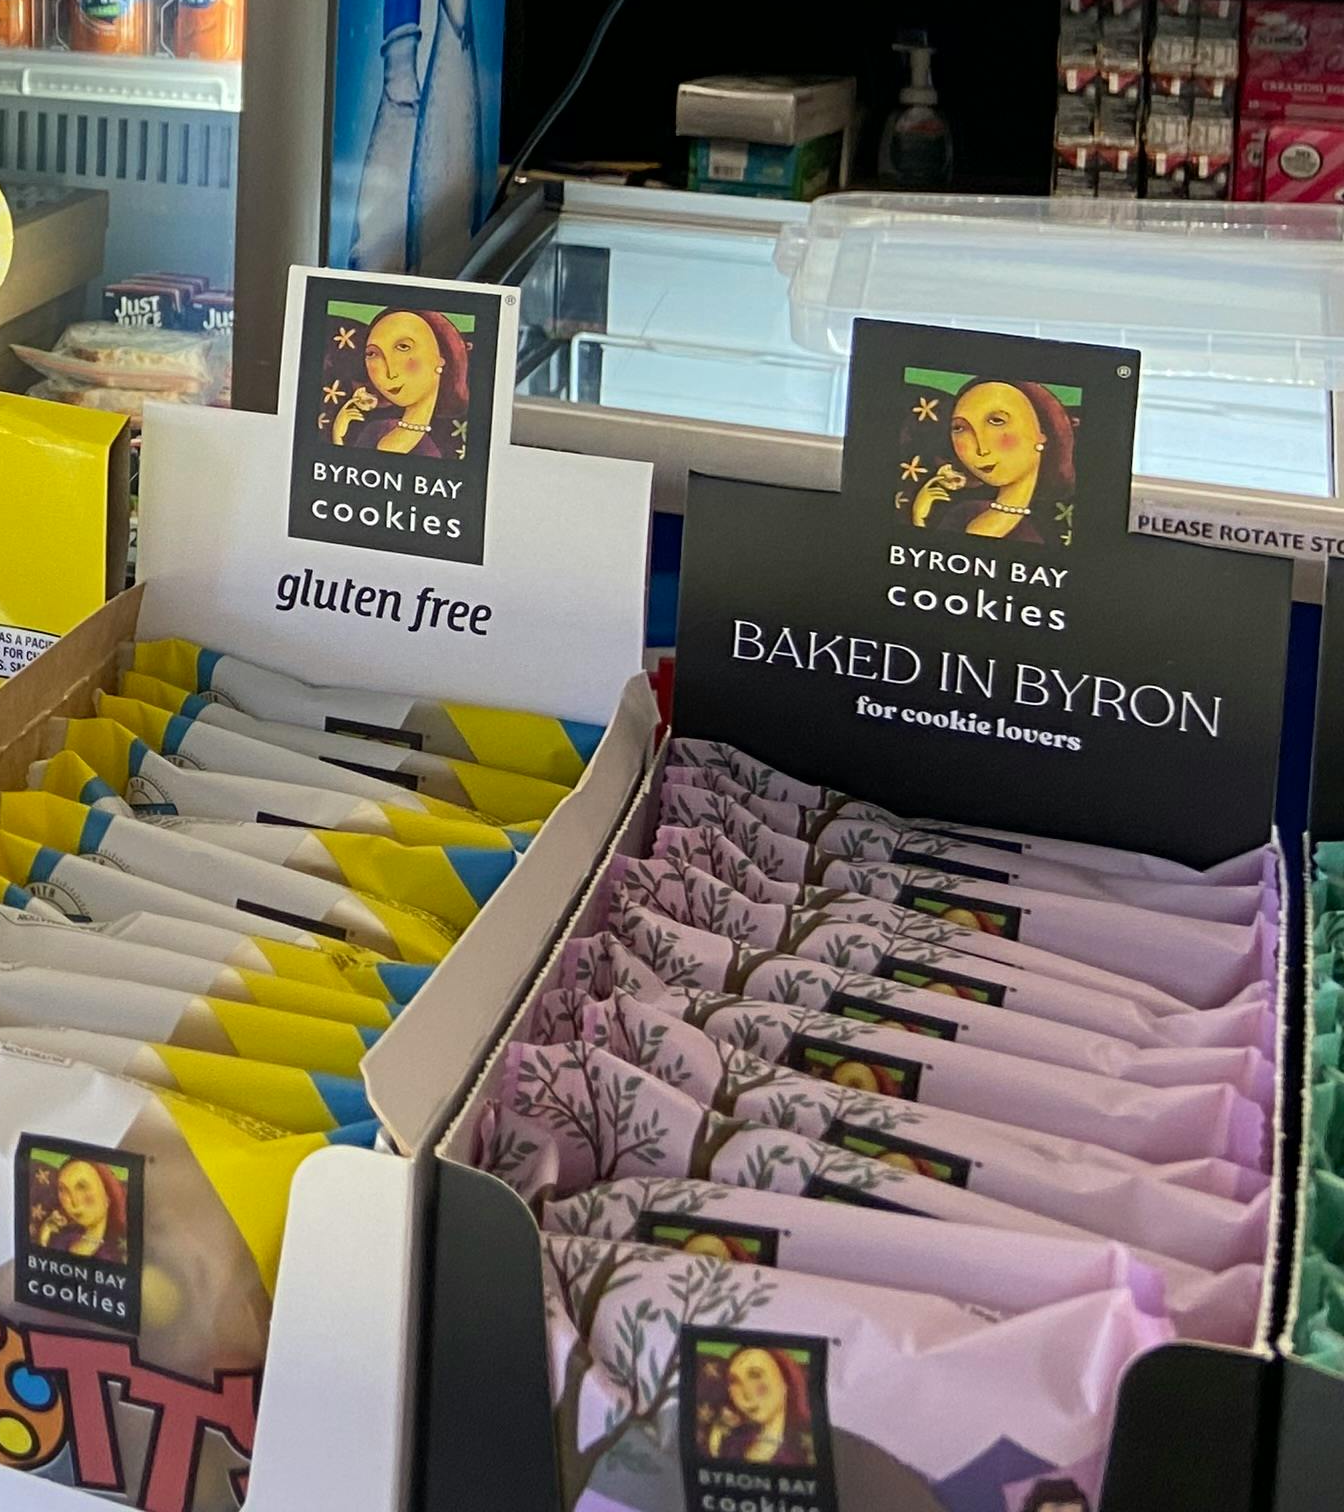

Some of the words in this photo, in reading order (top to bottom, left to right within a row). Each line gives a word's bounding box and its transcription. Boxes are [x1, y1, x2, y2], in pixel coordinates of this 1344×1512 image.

[115, 295, 160, 317] JUST
[314, 461, 403, 493] BYRON
[414, 475, 463, 500] BAY
[311, 497, 462, 540] cookies
[1137, 513, 1214, 540] PLEASE
[1219, 523, 1305, 552] ROTATE
[1310, 534, 1344, 557] STO
[889, 544, 997, 580] BYRON
[1011, 562, 1069, 589] BAY
[274, 568, 402, 623] gluten
[406, 585, 493, 636] free
[887, 583, 1068, 633] cookies
[3, 645, 23, 660] FOR
[15, 634, 23, 646] A
[730, 619, 922, 686] BAKED
[939, 650, 996, 699] IN
[1013, 662, 1223, 739] BYRON
[855, 695, 898, 721] for
[900, 704, 992, 738] cookie
[995, 717, 1082, 753] lovers
[26, 1255, 87, 1282] BYRON
[95, 1268, 128, 1292] BAY
[26, 1279, 128, 1319] cookies
[698, 1468, 772, 1492] BYRON
[778, 1477, 818, 1495] BAY
